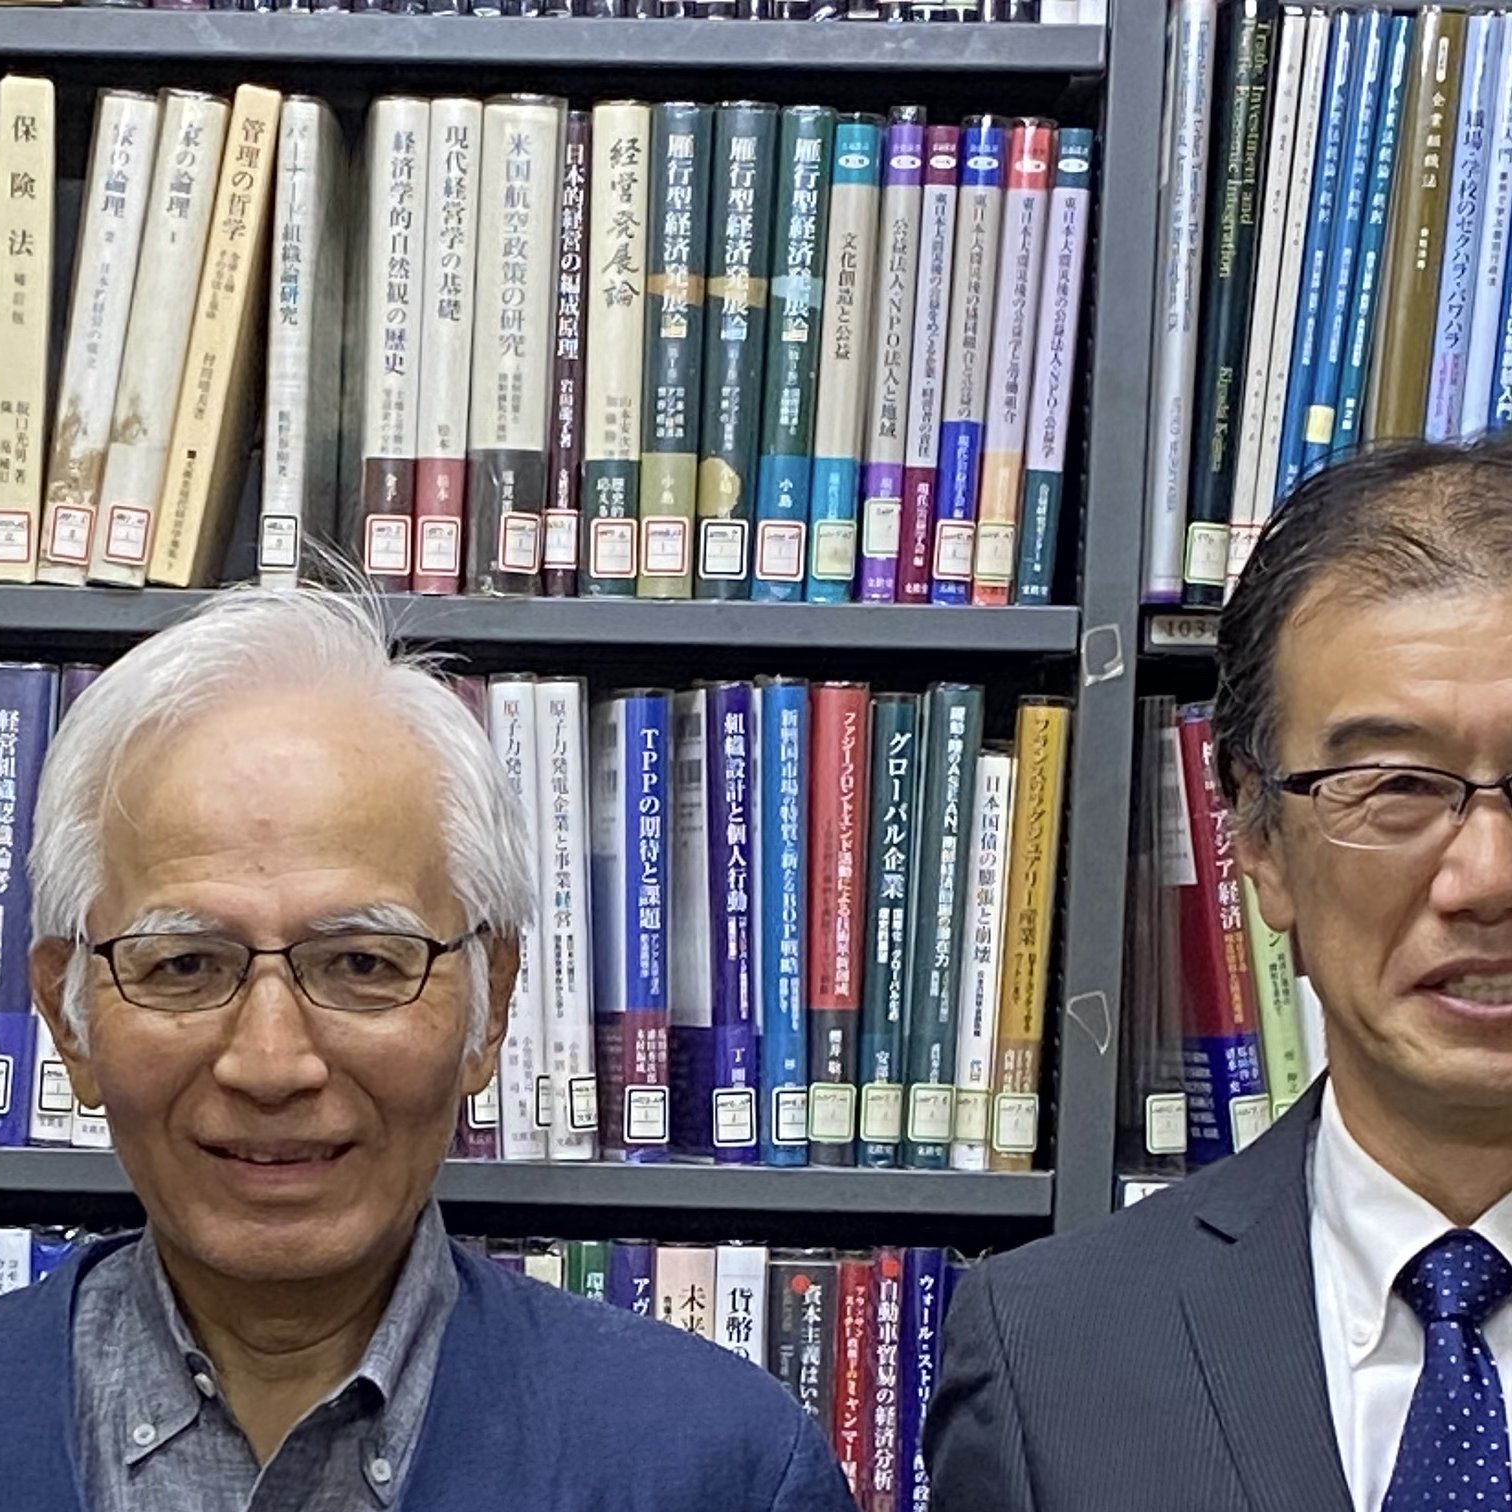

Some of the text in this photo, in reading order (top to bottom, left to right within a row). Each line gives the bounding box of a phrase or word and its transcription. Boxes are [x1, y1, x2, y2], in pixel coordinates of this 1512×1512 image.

[8, 115, 38, 258] 保険法
[222, 117, 266, 242] 管理の哲学
[383, 129, 415, 377] 経済学的自然観の歴史
[438, 124, 469, 322] 現代経営学の基礎
[497, 131, 535, 359] 米国航空政策の研究
[556, 143, 586, 363] 日本的経営の編成原理
[603, 136, 642, 309] 経営発展論
[660, 132, 695, 340] 雁行型経済発展論
[720, 136, 757, 342] 雁行型経済発展論
[781, 137, 821, 342] 雁行型経済発展論
[834, 231, 859, 361] 文化創造と公益
[549, 700, 572, 930] 原子力発電企業と事業経営
[638, 728, 661, 930] TPPの期待と課題
[724, 712, 748, 914] 組織設計と個人行動
[882, 731, 912, 901] グローバル企業
[872, 1277, 900, 1492] 自動車貿易の経済分析
